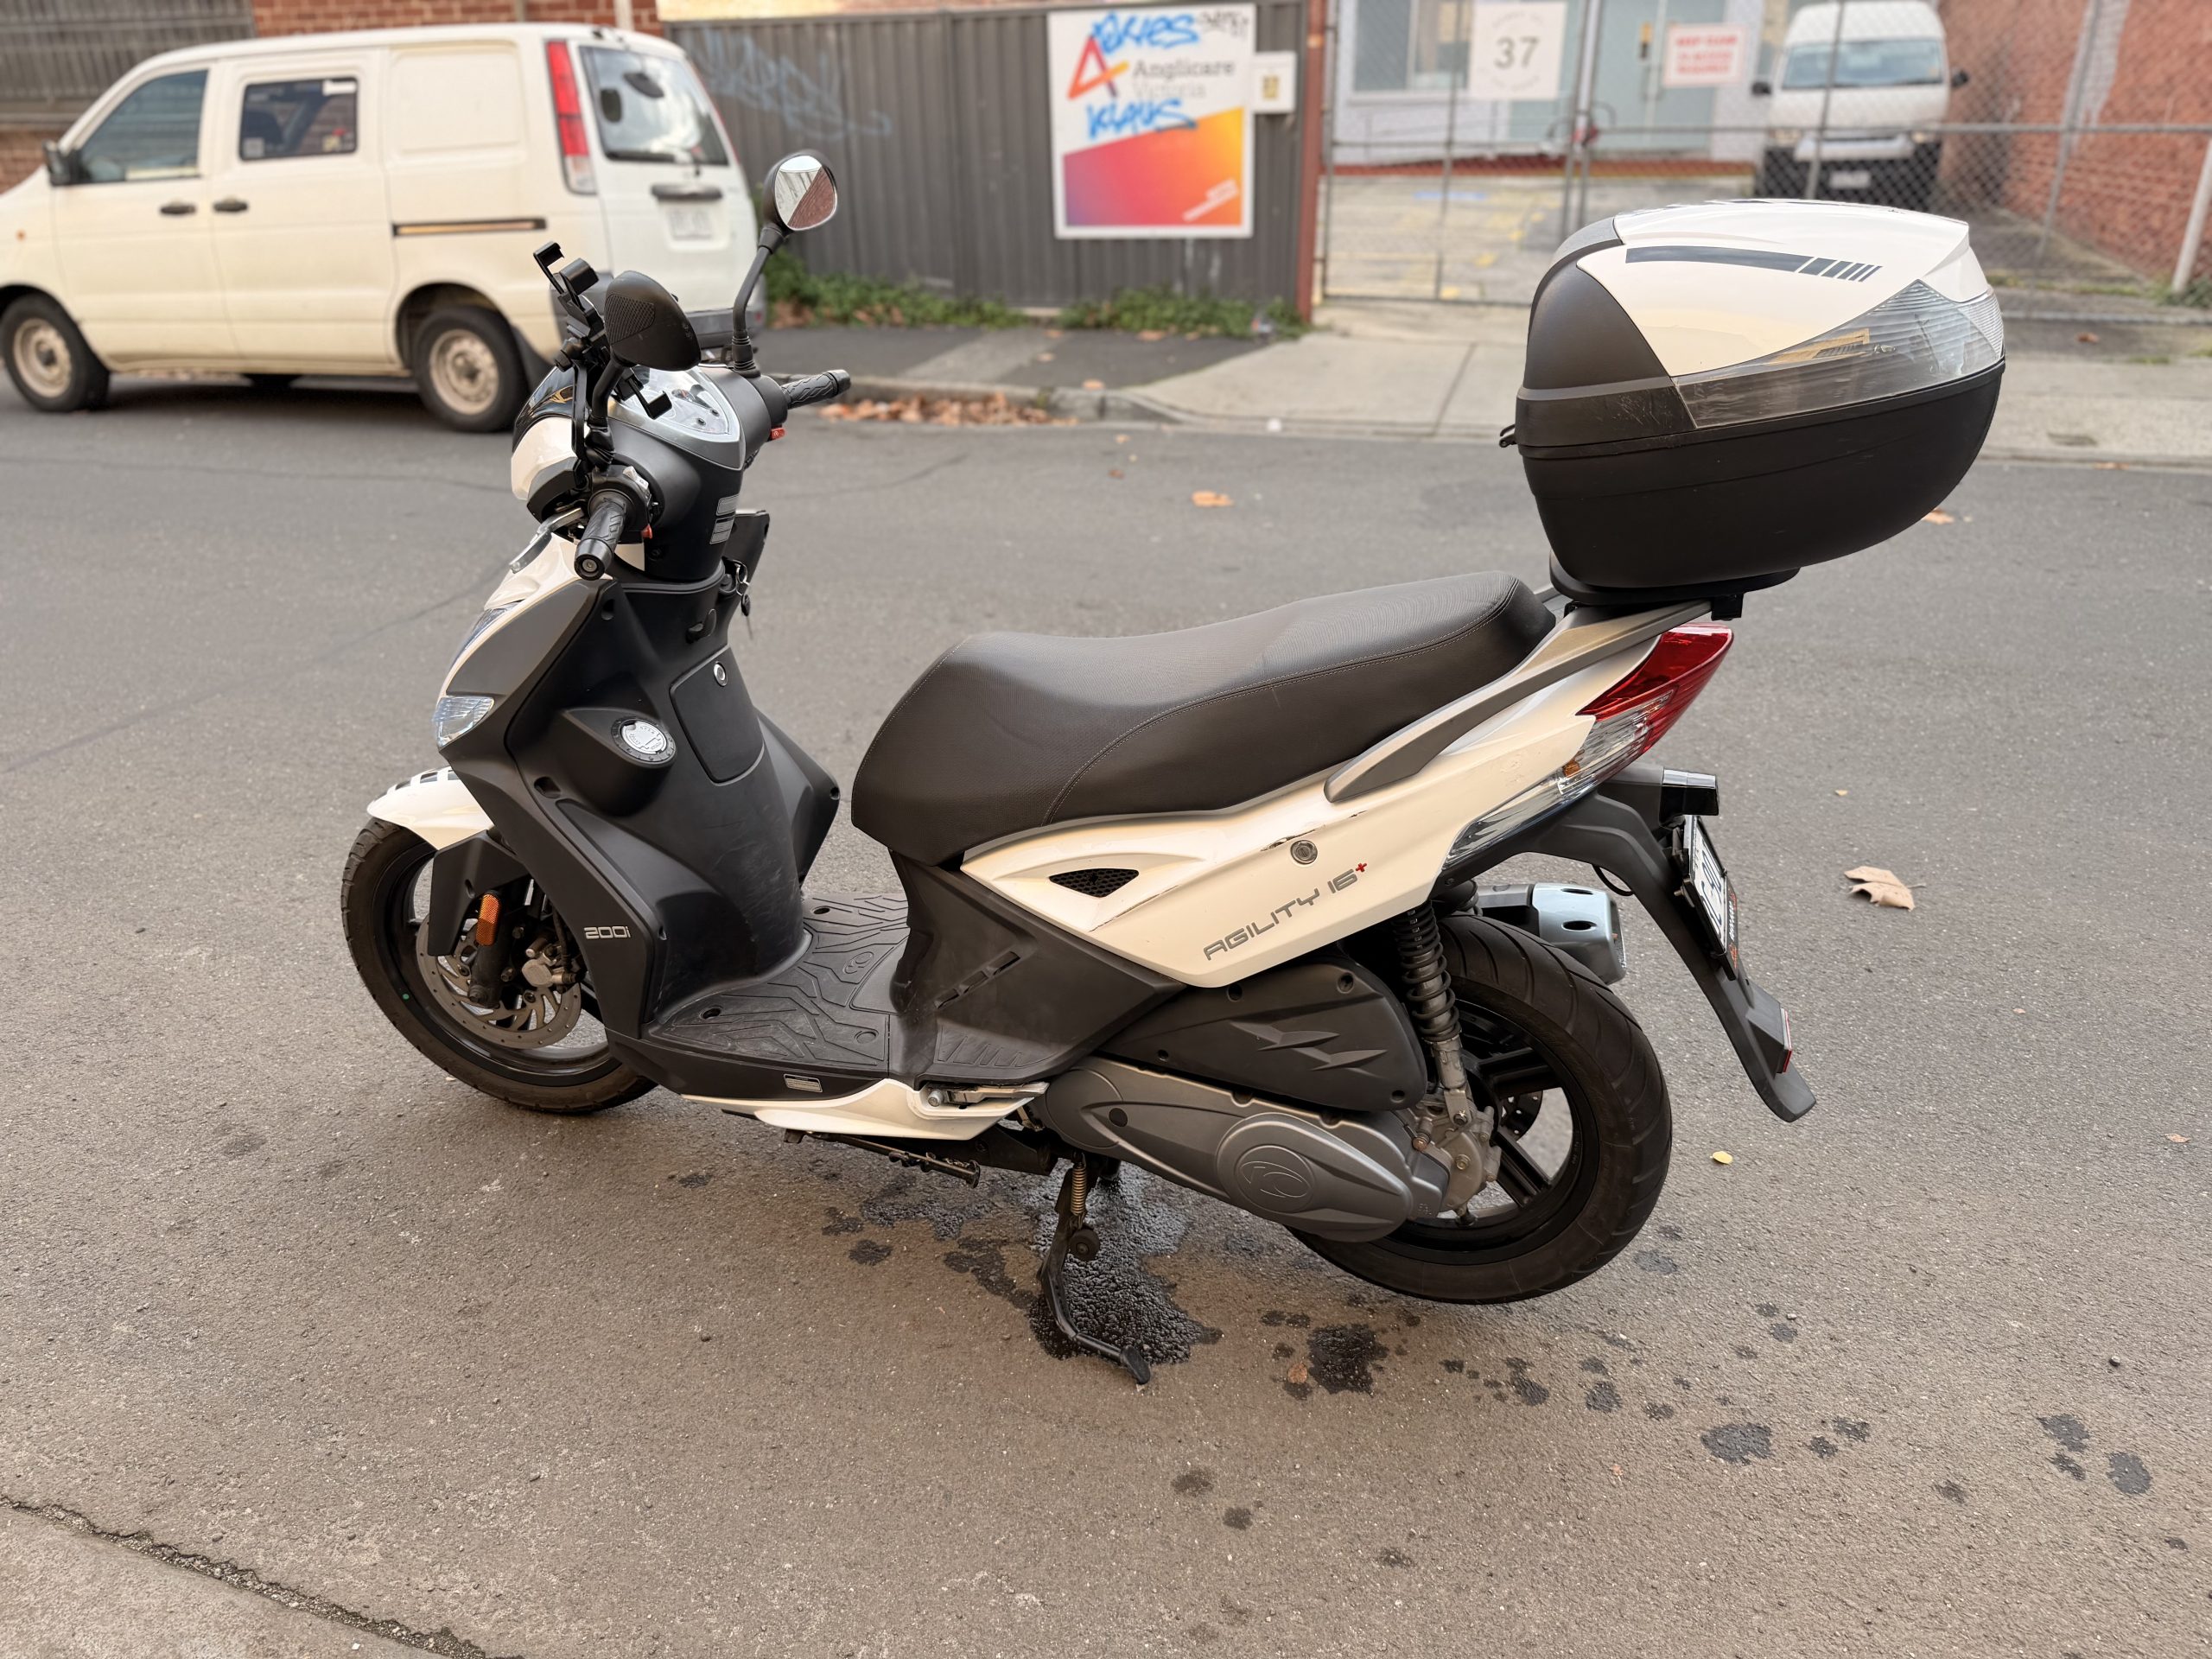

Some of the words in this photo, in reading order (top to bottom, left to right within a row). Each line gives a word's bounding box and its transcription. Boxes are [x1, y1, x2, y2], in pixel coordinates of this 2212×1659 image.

[1493, 36, 1540, 70] 37
[1134, 59, 1234, 81] Anglicare
[584, 925, 631, 939] 200i
[1204, 887, 1320, 961] AGILITY
